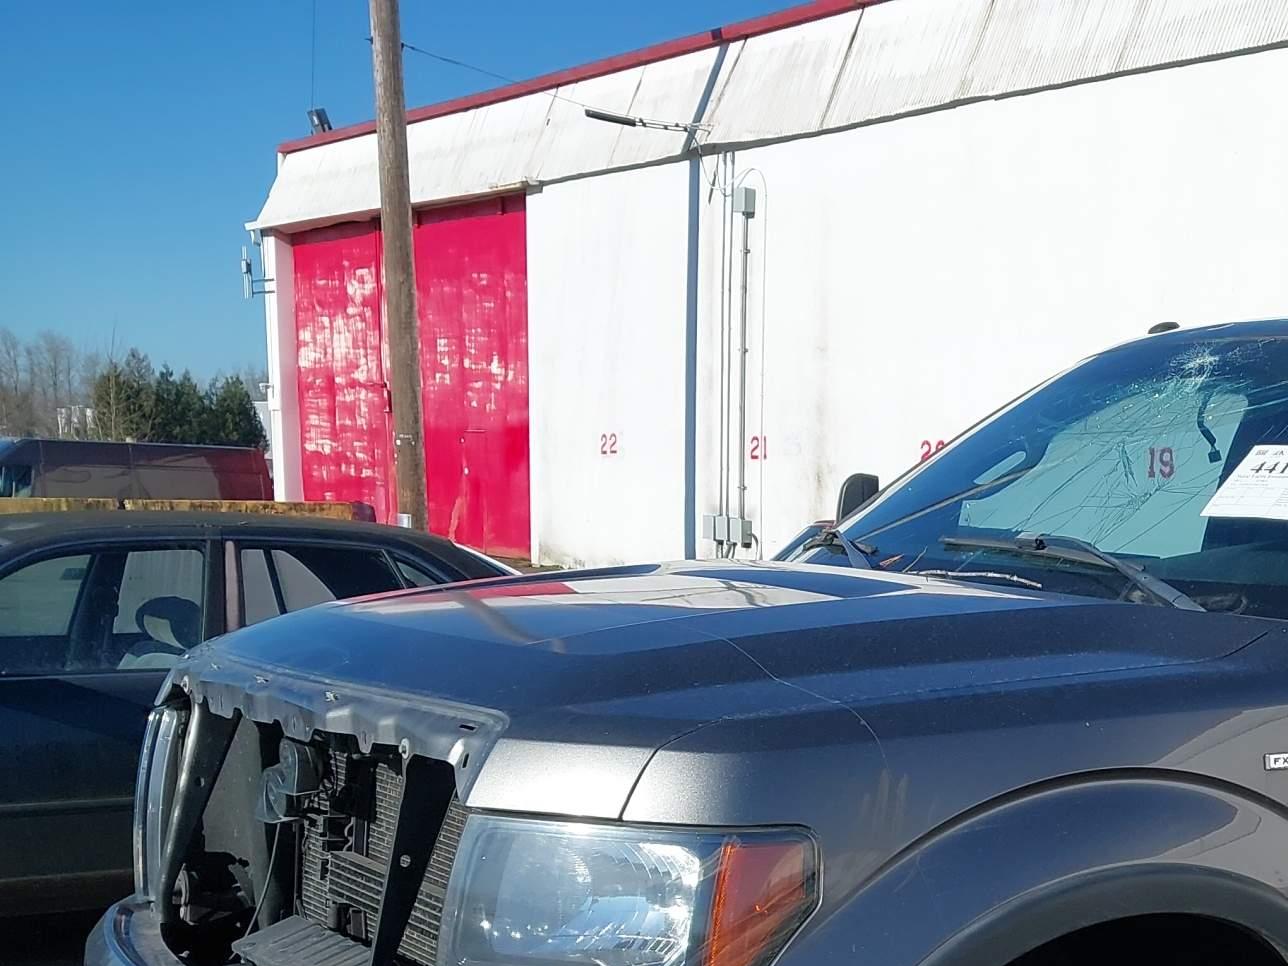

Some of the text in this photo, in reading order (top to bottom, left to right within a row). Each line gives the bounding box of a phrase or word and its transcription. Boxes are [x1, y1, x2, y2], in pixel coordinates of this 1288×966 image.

[600, 433, 617, 454] 22
[750, 436, 767, 460] 21
[1148, 447, 1174, 478] 19
